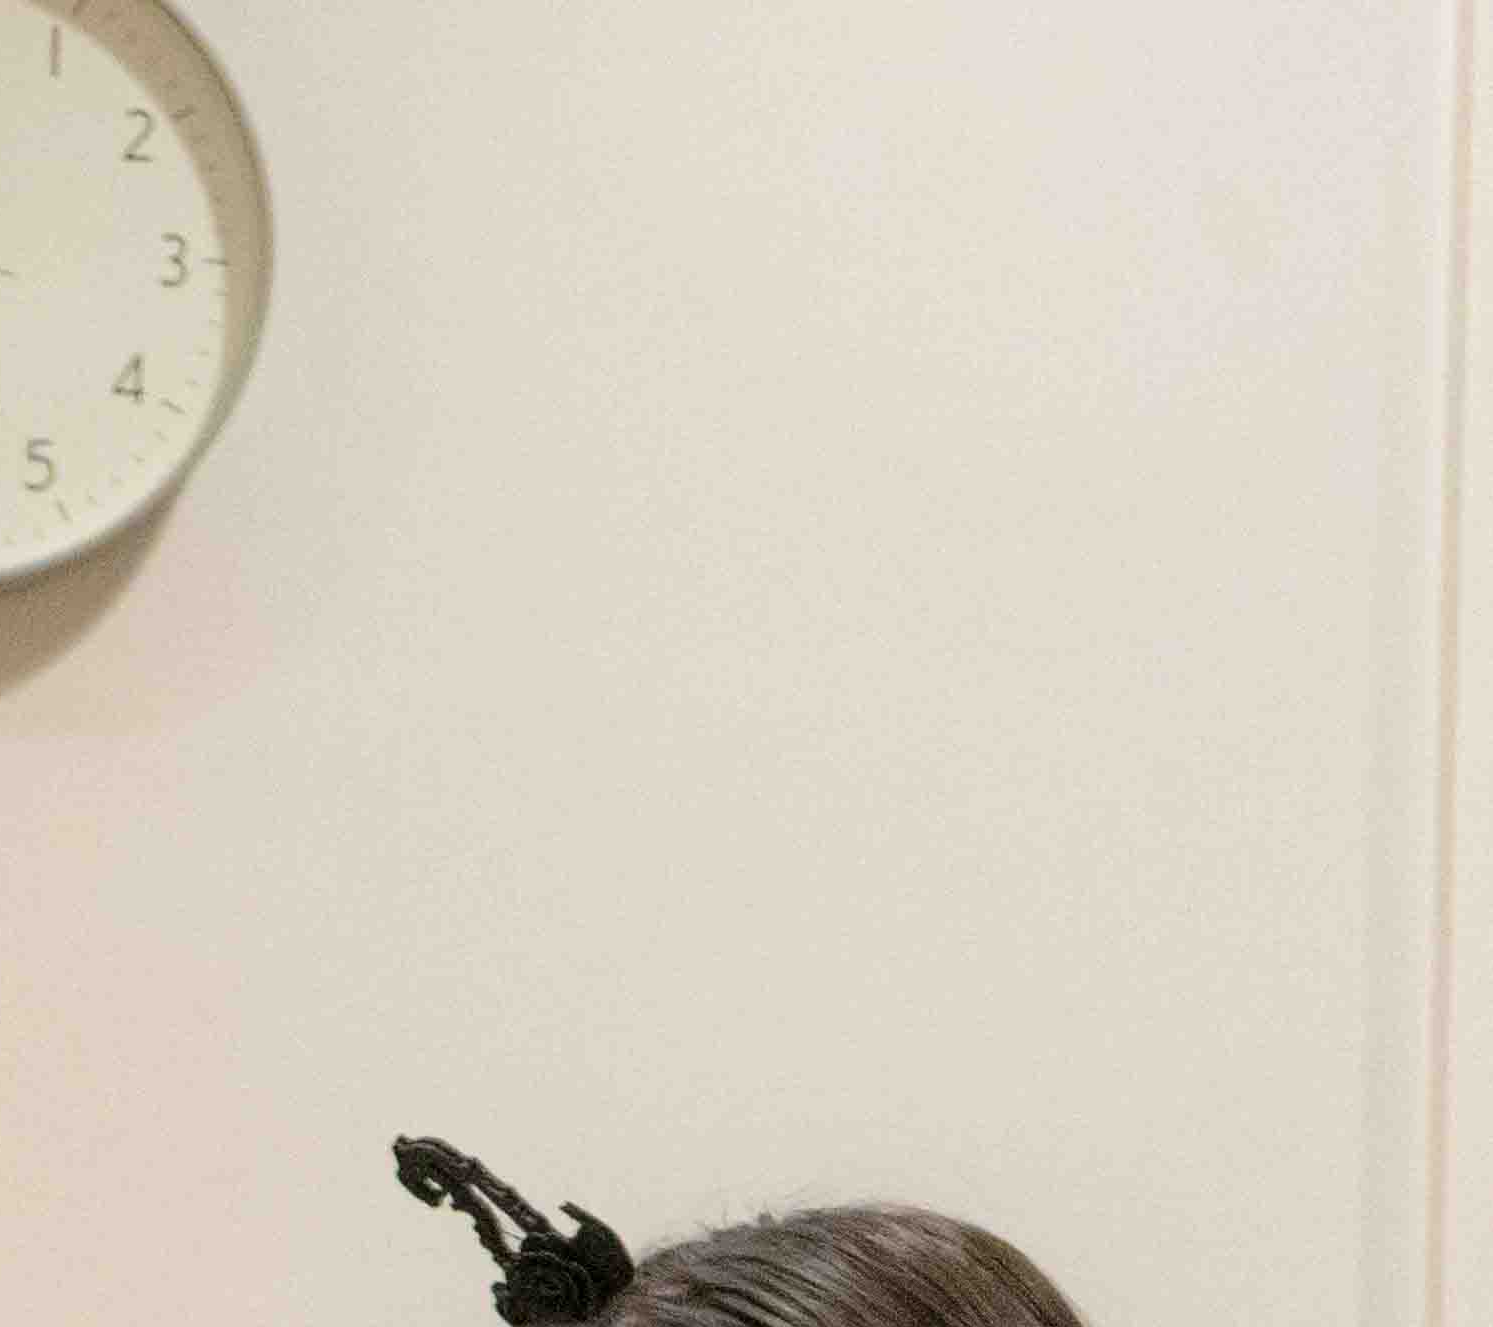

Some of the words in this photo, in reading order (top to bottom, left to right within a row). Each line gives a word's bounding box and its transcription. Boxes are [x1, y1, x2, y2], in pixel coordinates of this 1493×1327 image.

[48, 26, 62, 77] 1
[121, 109, 155, 164] 2
[161, 233, 191, 288] 3
[113, 354, 147, 402] 4
[24, 439, 55, 492] 5
